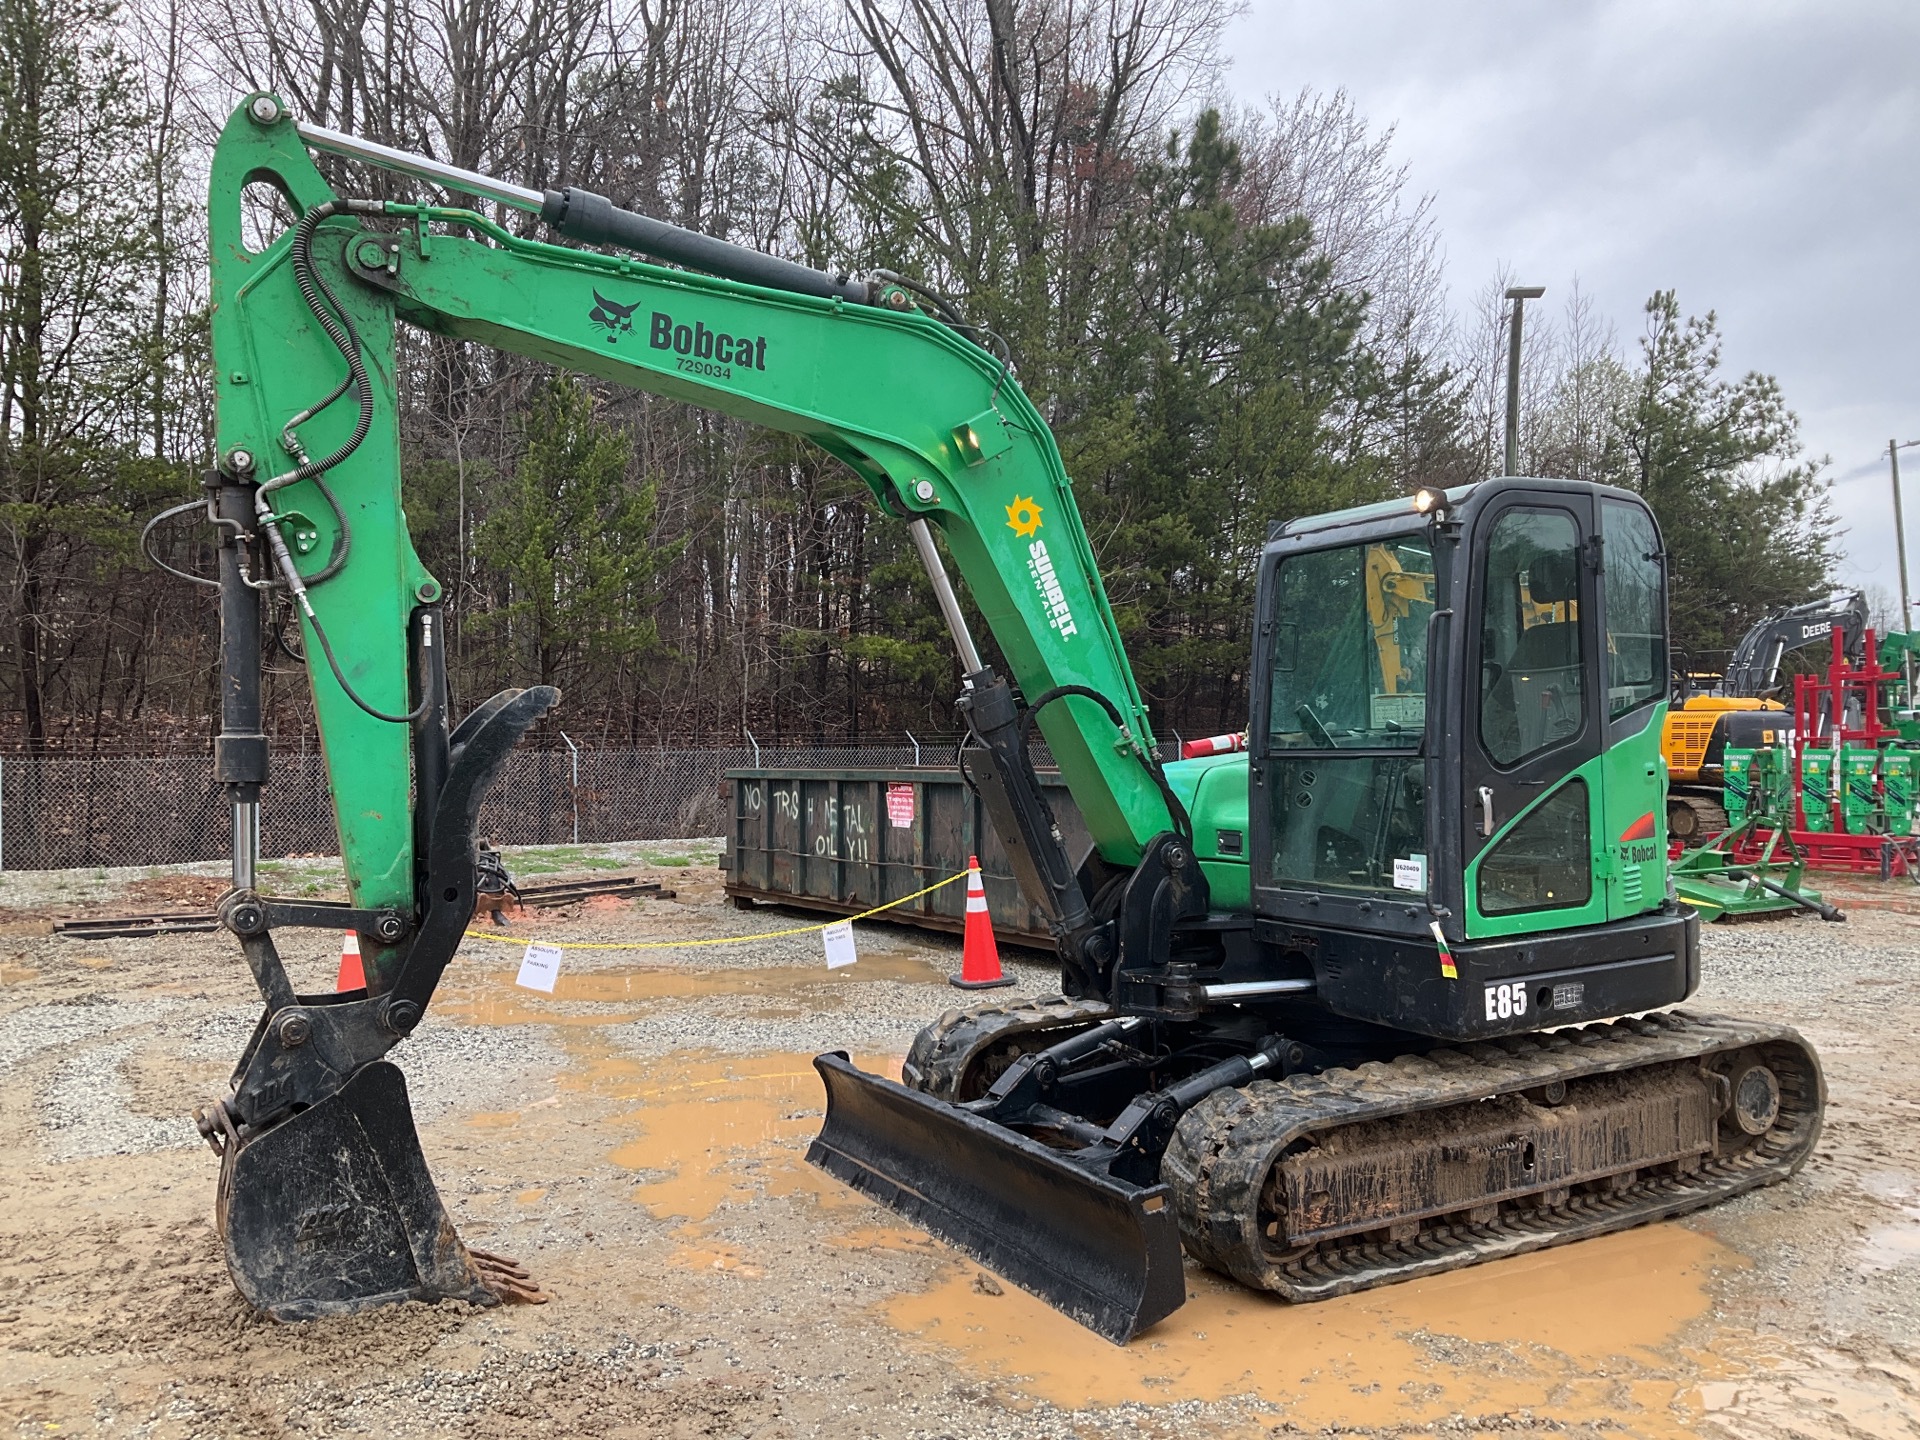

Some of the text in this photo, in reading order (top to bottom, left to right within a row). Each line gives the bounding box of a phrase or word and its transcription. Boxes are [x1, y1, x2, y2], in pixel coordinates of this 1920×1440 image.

[650, 311, 767, 371] Bobcat
[676, 358, 731, 379] 729034
[1026, 559, 1057, 629] RENTALS
[1028, 539, 1078, 638] SUNBELT
[1802, 621, 1832, 639] DEERE
[744, 784, 761, 810] NO
[1631, 843, 1657, 864] Bobcat
[1485, 982, 1528, 1021] E85
